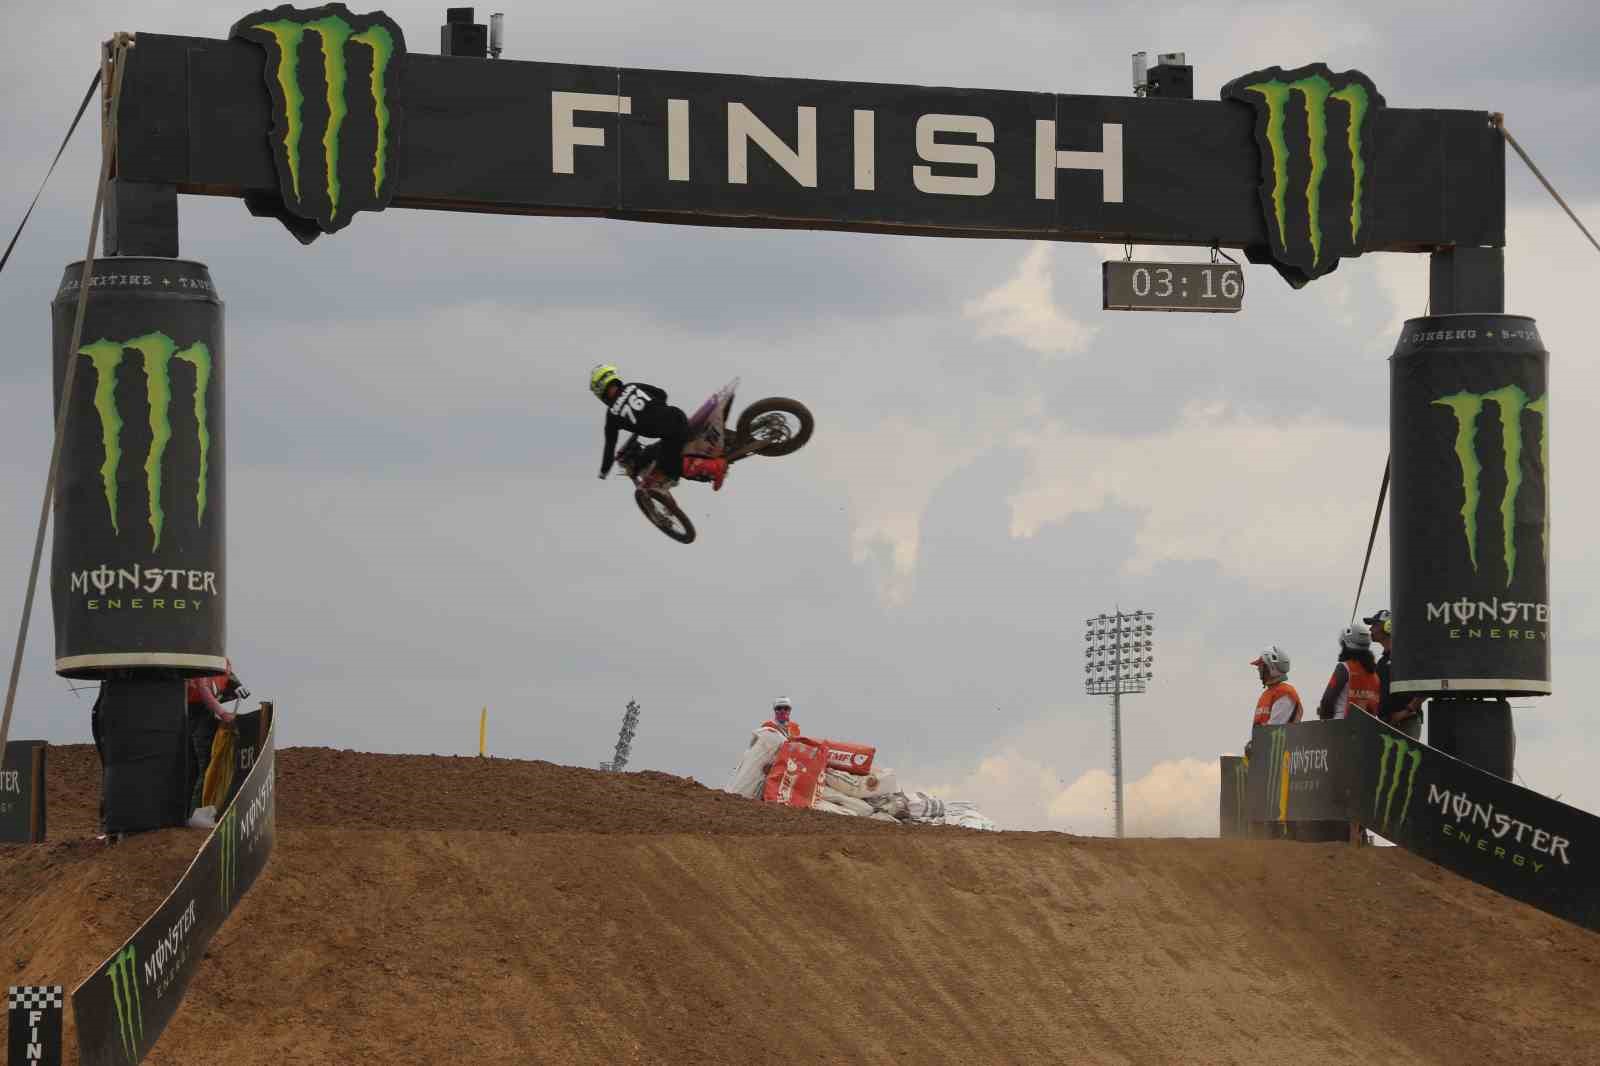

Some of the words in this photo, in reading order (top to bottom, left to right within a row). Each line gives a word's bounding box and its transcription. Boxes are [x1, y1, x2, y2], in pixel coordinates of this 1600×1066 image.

[551, 91, 1124, 203] FINISH
[1131, 267, 1240, 299] 03:16
[620, 389, 652, 424] 761
[70, 563, 218, 595] MONSTER
[87, 599, 202, 610] ENERGY
[1427, 784, 1570, 865] MONSTER
[1442, 824, 1544, 873] ENERGY
[144, 899, 196, 985] MONSTER
